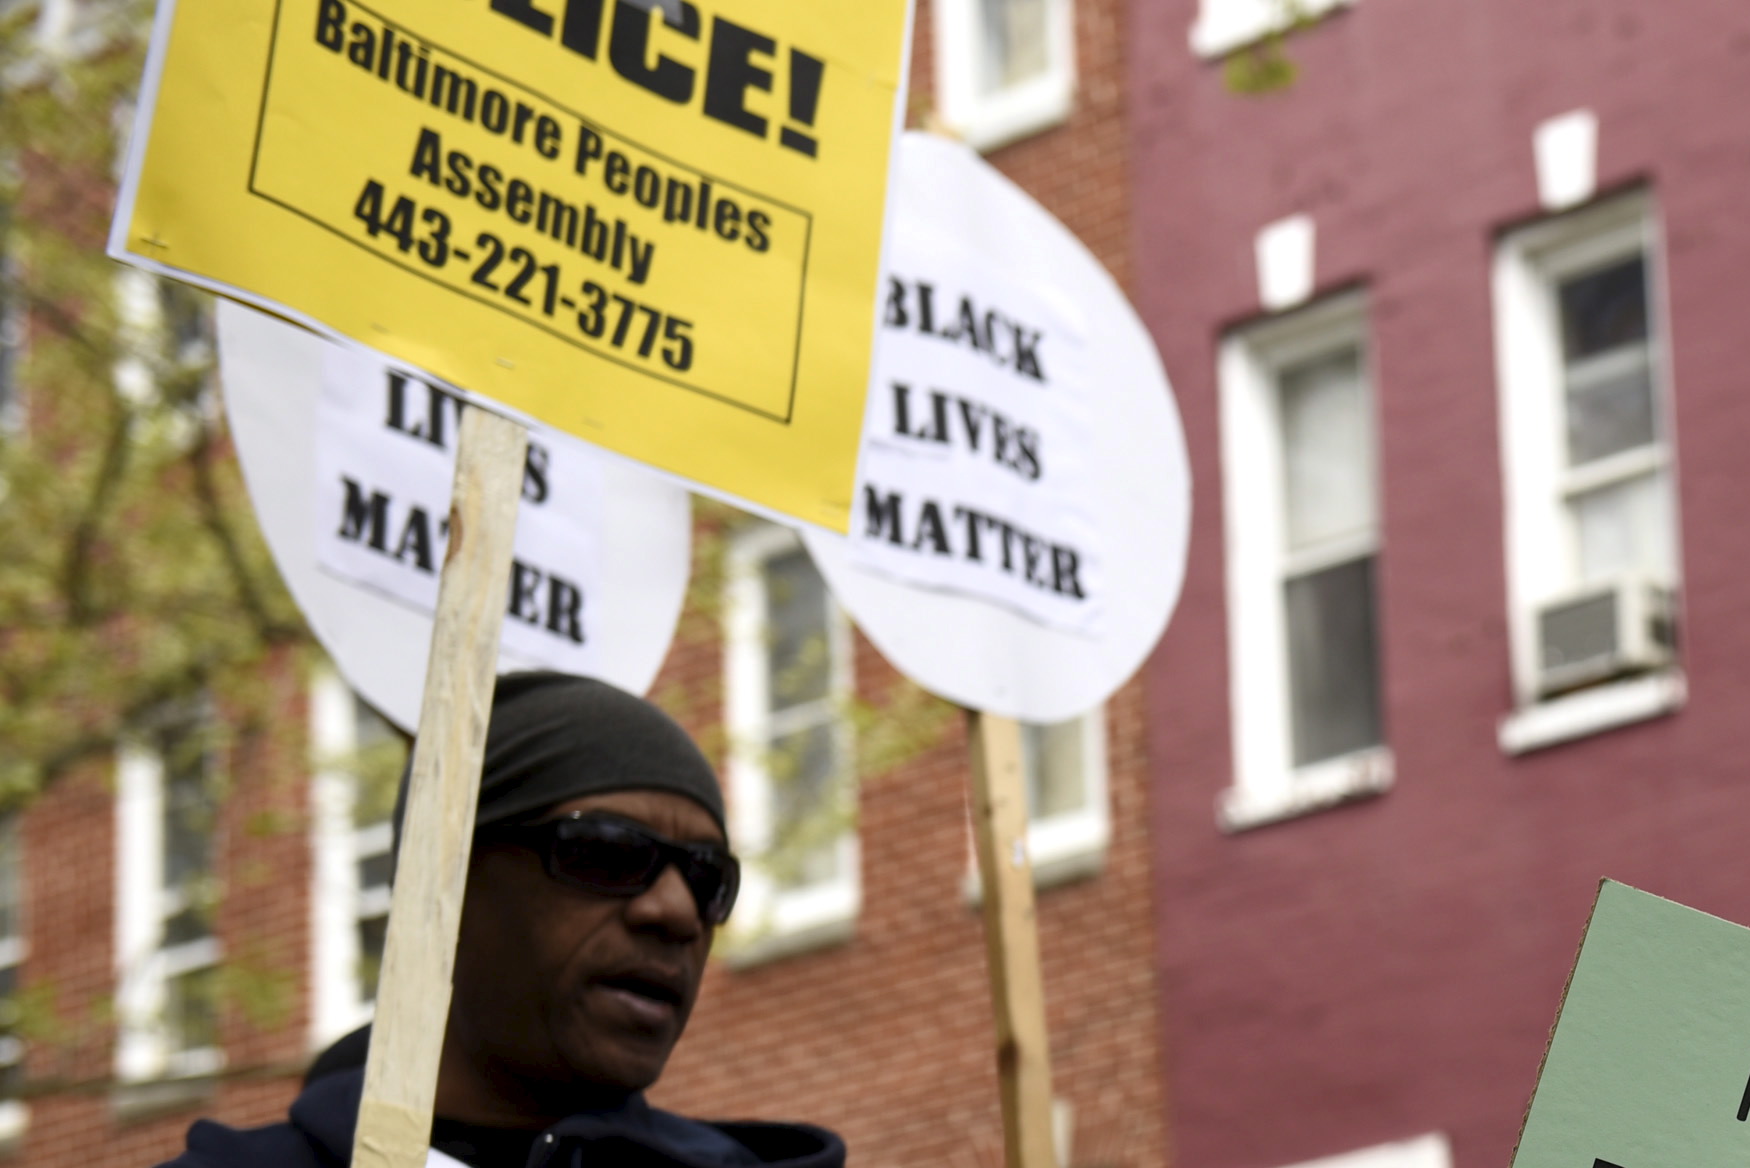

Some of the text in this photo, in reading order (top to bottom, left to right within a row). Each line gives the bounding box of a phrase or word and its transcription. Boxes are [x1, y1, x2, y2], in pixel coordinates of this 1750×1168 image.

[315, 0, 772, 254] Baltimore Peoples
[353, 178, 695, 373] 443-221-3775
[409, 126, 656, 287] Assembly
[885, 275, 1047, 384] BLACK
[384, 372, 550, 505] LIS
[890, 381, 1043, 482] LIVES
[337, 473, 585, 646] MAER
[863, 483, 1088, 601] MATTER
